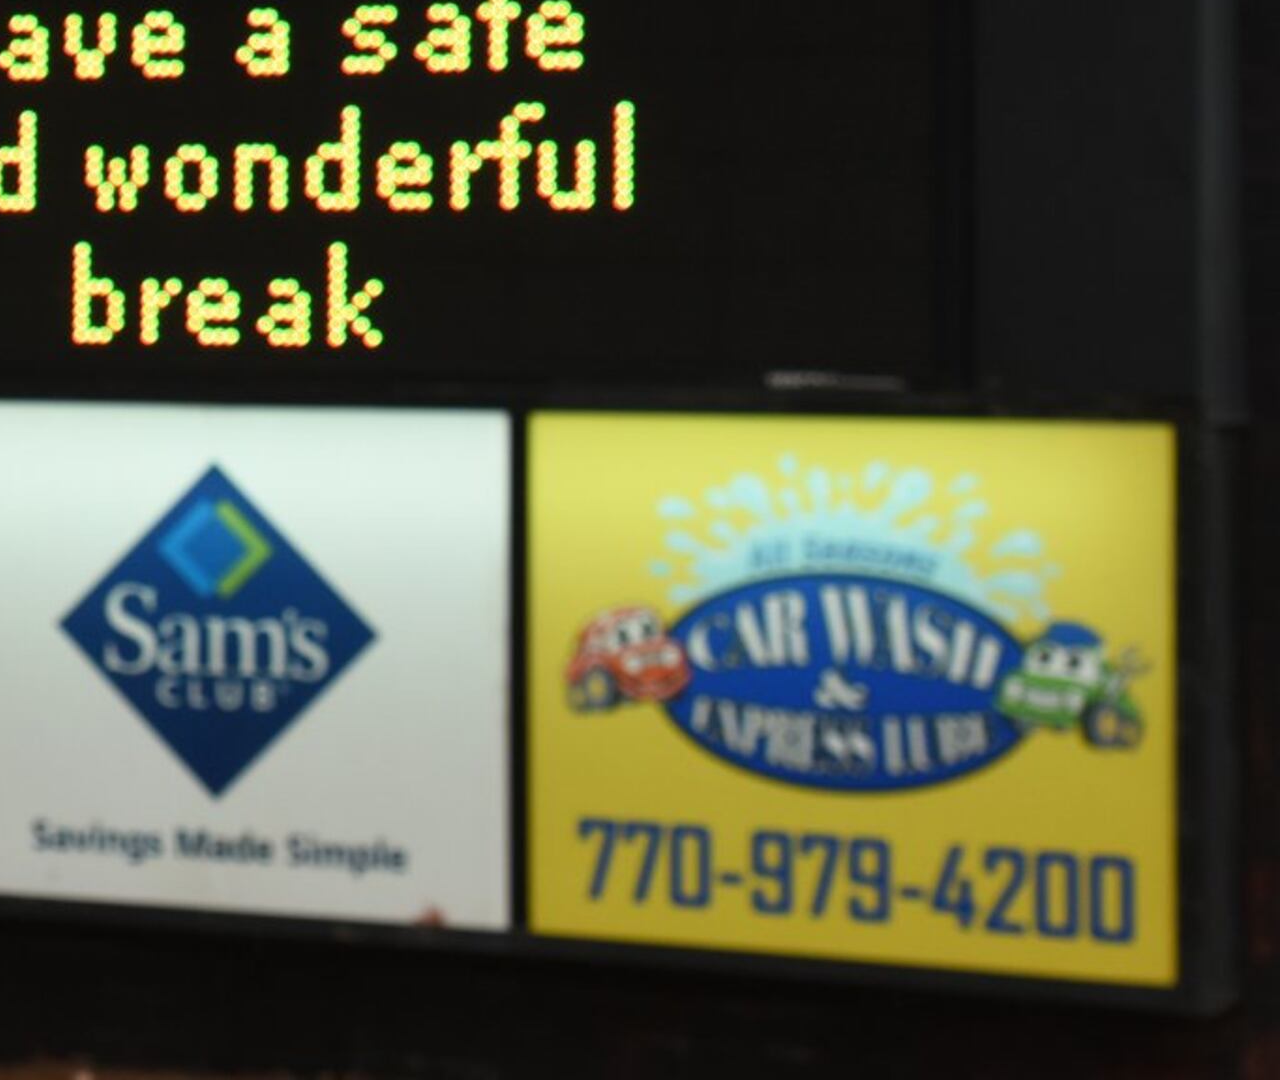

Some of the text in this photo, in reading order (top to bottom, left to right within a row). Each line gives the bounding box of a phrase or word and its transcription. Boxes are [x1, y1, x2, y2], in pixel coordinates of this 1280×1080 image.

[235, 7, 290, 76] a
[84, 100, 635, 212] wonderful
[72, 240, 384, 349] break
[103, 581, 330, 683] Sam's
[687, 582, 1003, 690] CAR WASH
[154, 676, 277, 712] CLUB
[813, 669, 868, 711] &
[32, 817, 408, 877] Savings Made Simple
[577, 816, 1137, 945] 770-979-4200
